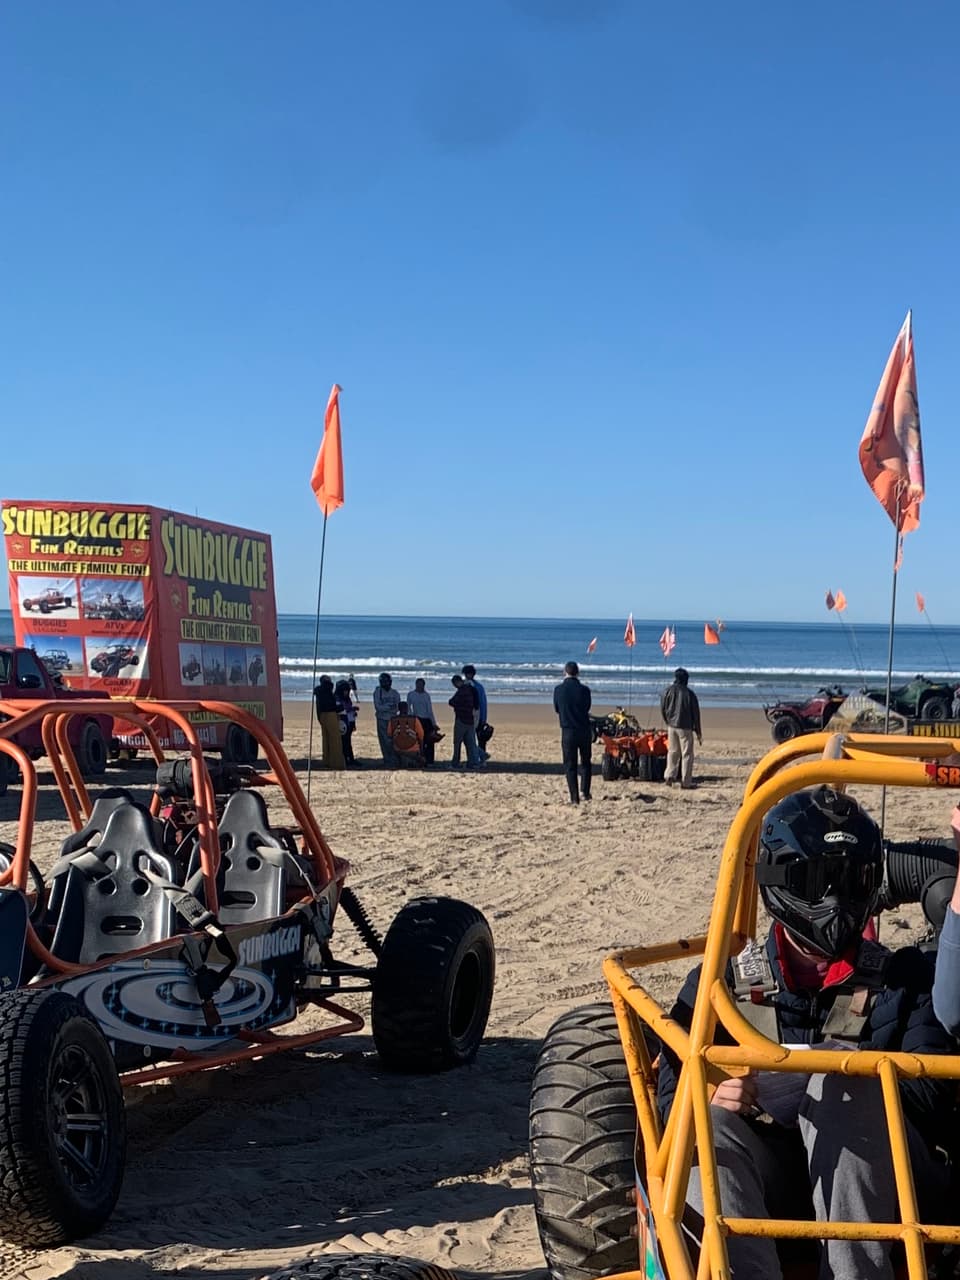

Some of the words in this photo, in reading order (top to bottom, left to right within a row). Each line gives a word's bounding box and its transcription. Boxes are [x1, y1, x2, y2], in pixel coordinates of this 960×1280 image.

[2, 507, 150, 540] SUNBUGGIE
[11, 560, 28, 571] THE
[31, 560, 77, 573] ULTIMATE
[80, 562, 117, 575] FAMILY
[121, 564, 147, 577] FUN!
[161, 516, 266, 590] SUNBUGGIE
